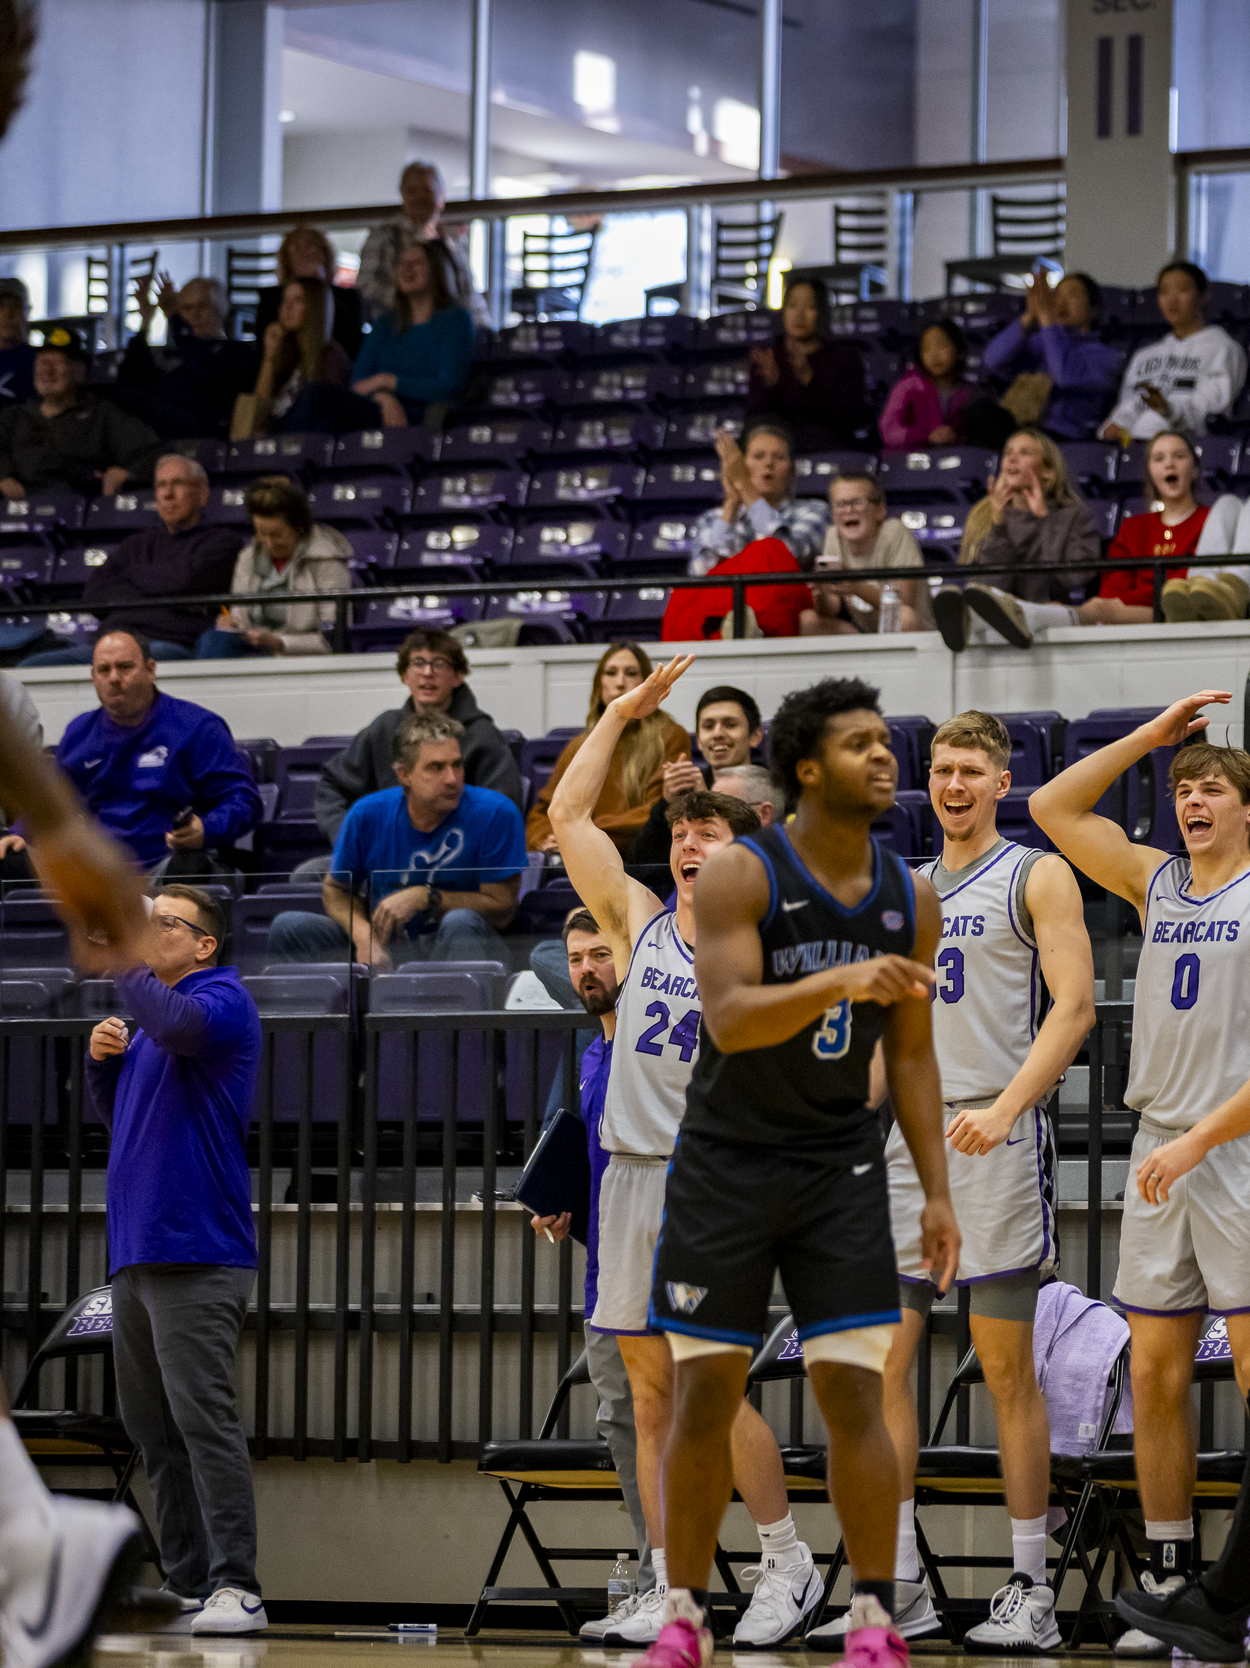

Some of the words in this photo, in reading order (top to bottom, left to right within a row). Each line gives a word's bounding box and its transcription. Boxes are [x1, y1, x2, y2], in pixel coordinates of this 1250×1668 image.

[772, 940, 884, 976] WILLIA
[1152, 920, 1240, 943] BEARCATS
[932, 946, 965, 1004] 3
[1171, 953, 1200, 1010] 0
[635, 1000, 700, 1063] 24
[812, 998, 852, 1060] 3
